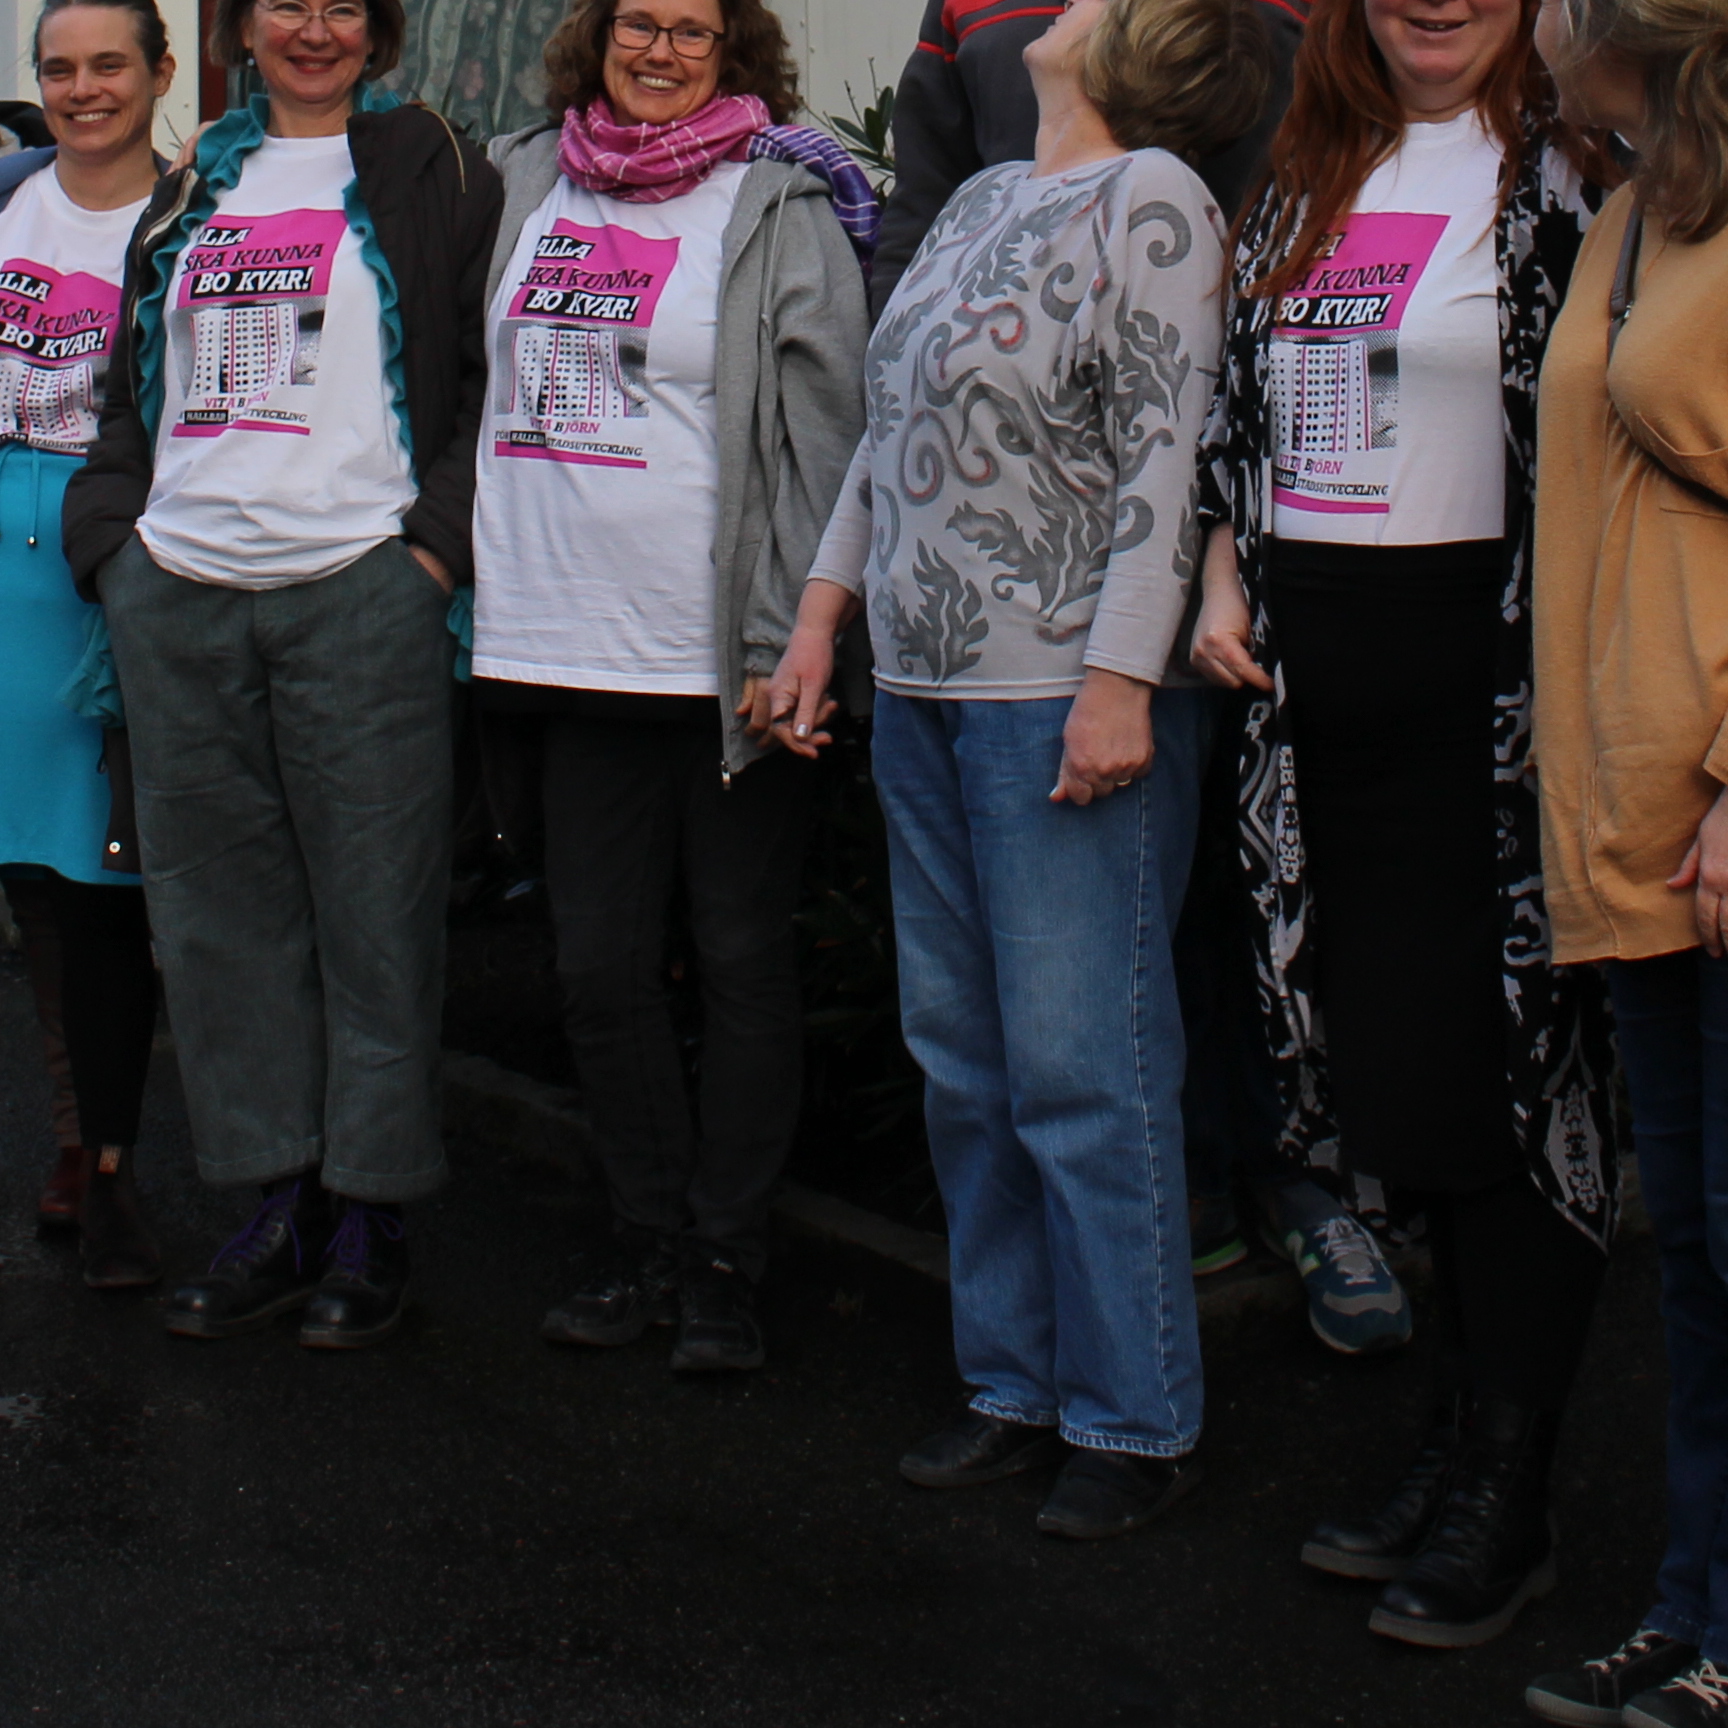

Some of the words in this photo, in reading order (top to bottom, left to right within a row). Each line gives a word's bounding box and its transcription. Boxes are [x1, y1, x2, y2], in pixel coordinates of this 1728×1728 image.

[180, 251, 228, 275] SKA
[229, 244, 325, 266] KUNNA
[536, 237, 594, 260] ALLA
[194, 271, 231, 294] BO
[235, 266, 315, 292] KVAR!
[519, 266, 565, 286] SKA
[566, 268, 654, 290] KUNNA
[1311, 263, 1412, 290] KUNNA
[526, 290, 564, 311] BO
[565, 292, 641, 320] KVAR!
[1311, 293, 1393, 325] KVAR!
[38, 326, 108, 359] KVAR!
[553, 422, 602, 435] BJÖRN
[1304, 458, 1344, 476] BJÖRN
